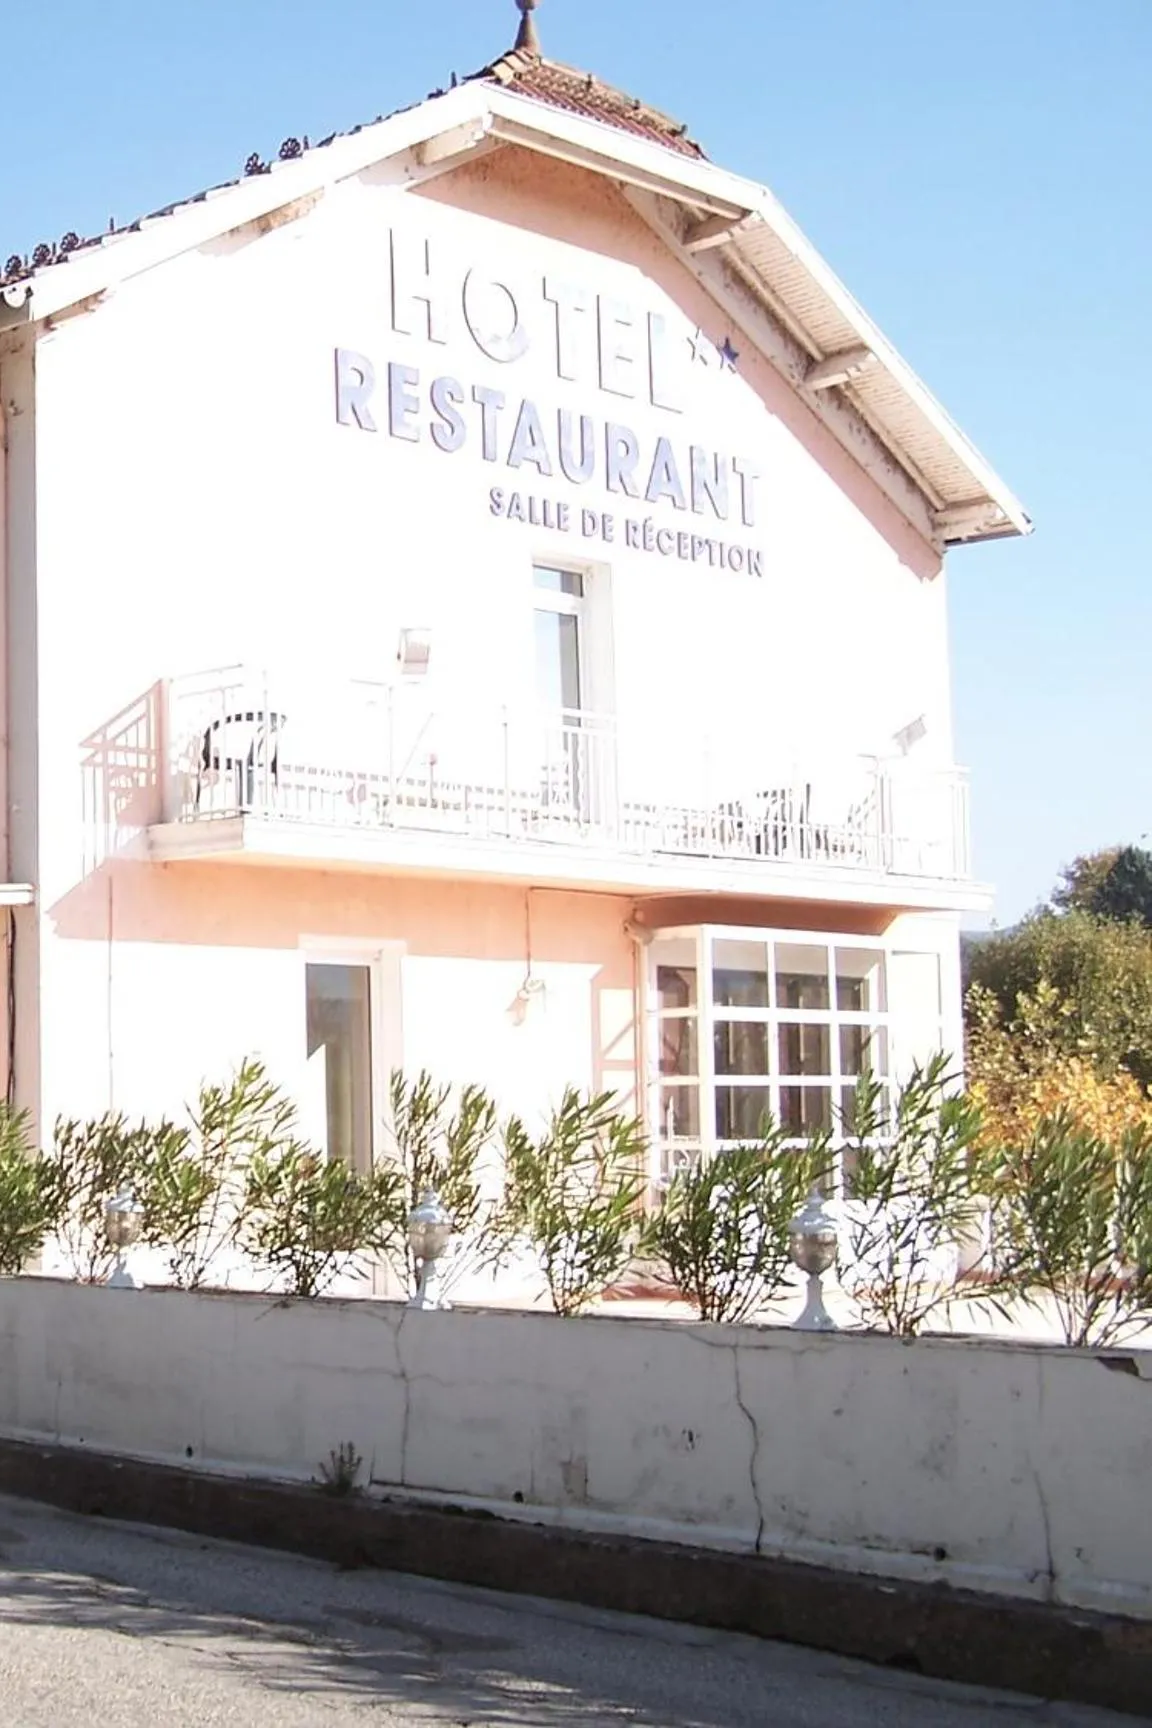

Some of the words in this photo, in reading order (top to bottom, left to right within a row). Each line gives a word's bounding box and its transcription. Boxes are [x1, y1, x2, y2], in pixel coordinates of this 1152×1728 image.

[389, 228, 684, 414] HOTEL
[334, 347, 762, 528] RESTAURANT
[489, 486, 570, 532] SALLE
[581, 508, 614, 543] DE
[625, 516, 764, 578] RÉCEPTION
